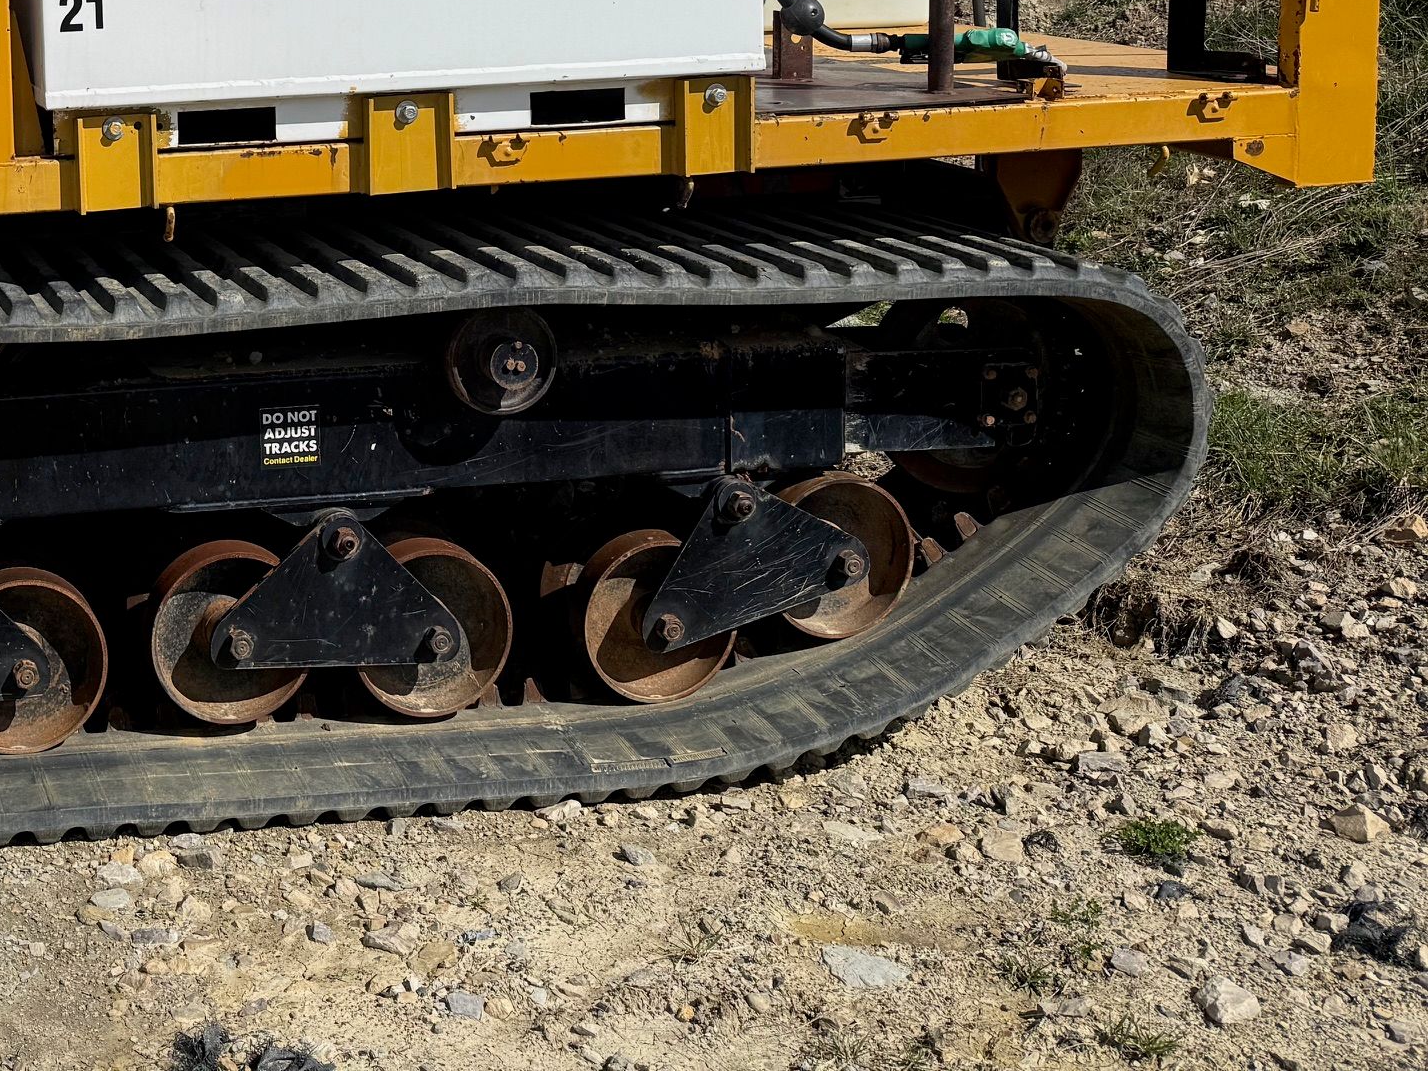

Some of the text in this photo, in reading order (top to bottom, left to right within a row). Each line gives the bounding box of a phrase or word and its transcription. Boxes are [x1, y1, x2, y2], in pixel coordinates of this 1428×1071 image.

[262, 410, 318, 425] DO NOT
[264, 425, 317, 439] ADJUST
[263, 440, 318, 455] TRACKS
[263, 455, 318, 466] Contact Dealer
